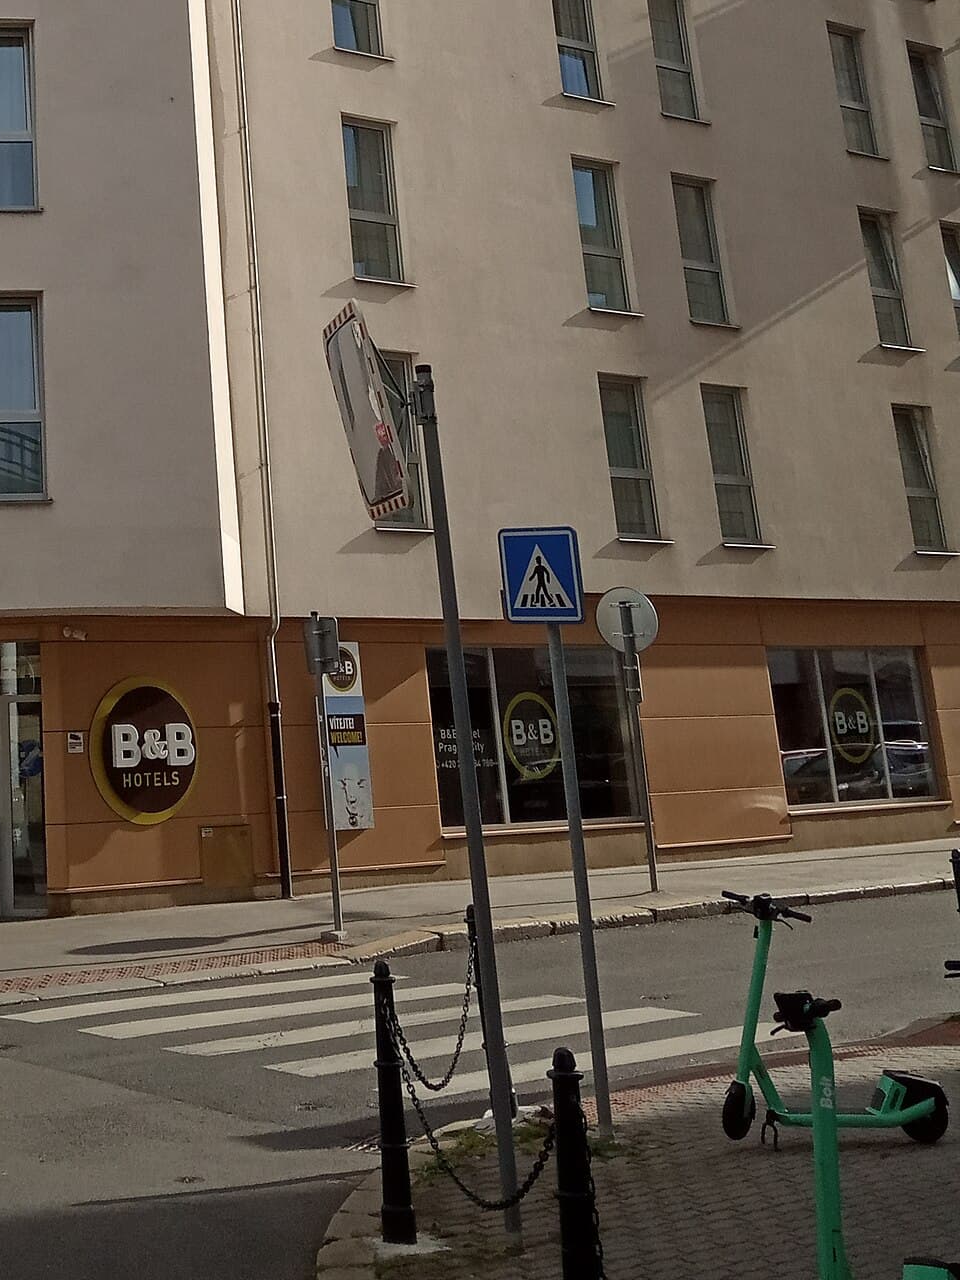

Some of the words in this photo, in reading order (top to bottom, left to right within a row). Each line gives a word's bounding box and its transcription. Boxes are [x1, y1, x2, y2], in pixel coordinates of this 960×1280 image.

[329, 716, 355, 730] VÍTEJTE!
[510, 718, 554, 746] B&B
[834, 710, 869, 734] B&B
[111, 723, 196, 768] B&B
[330, 731, 363, 744] WELCOME!
[122, 771, 180, 788] HOTELS
